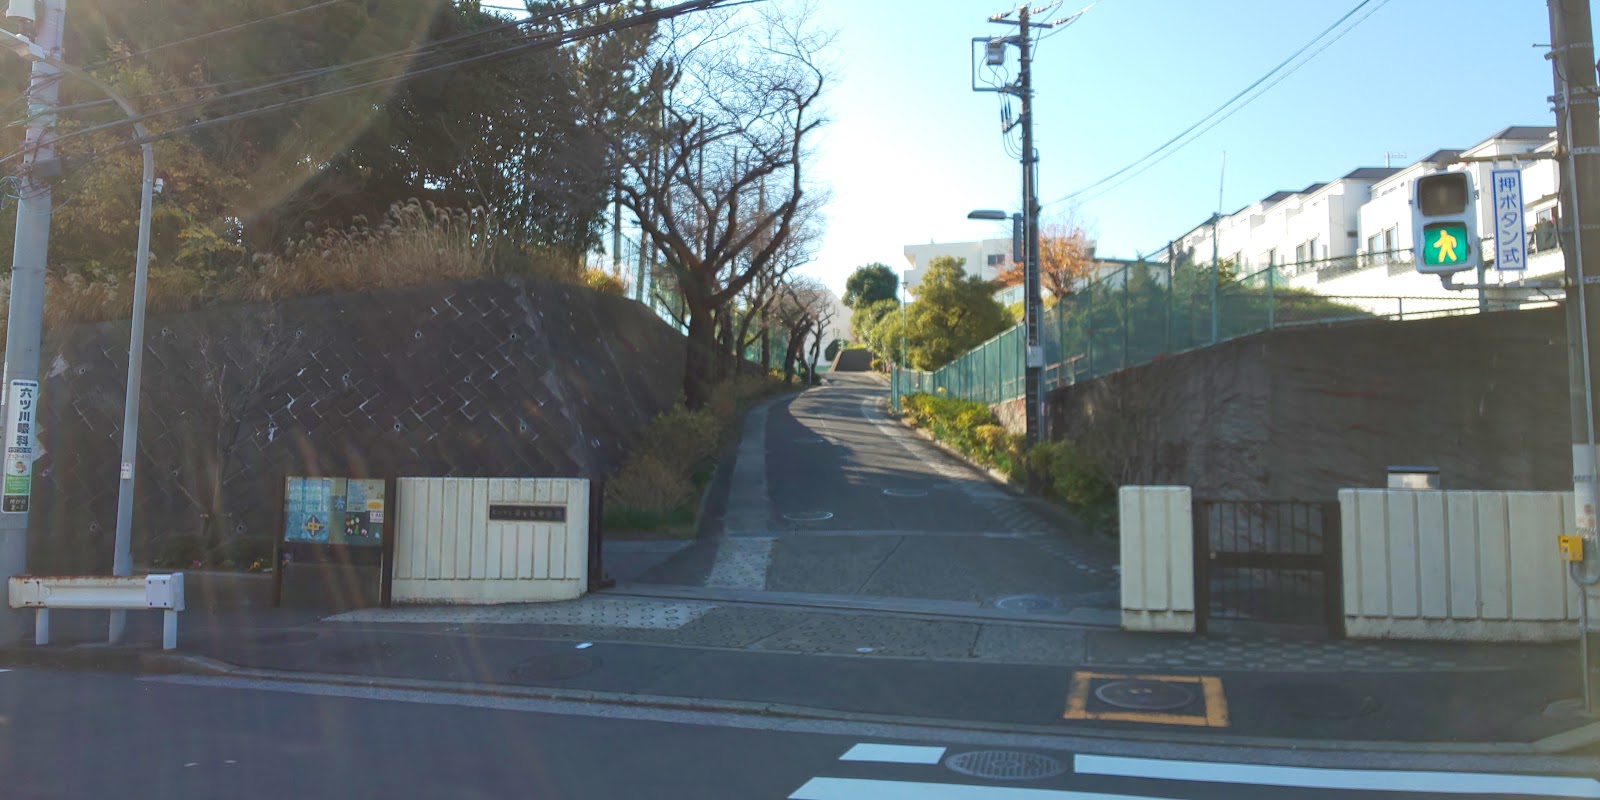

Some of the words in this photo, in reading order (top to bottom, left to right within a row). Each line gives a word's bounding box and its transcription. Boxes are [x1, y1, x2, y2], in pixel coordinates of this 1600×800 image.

[1499, 176, 1520, 264] 押ボタン式
[16, 387, 32, 447] 六ツ川眼科
